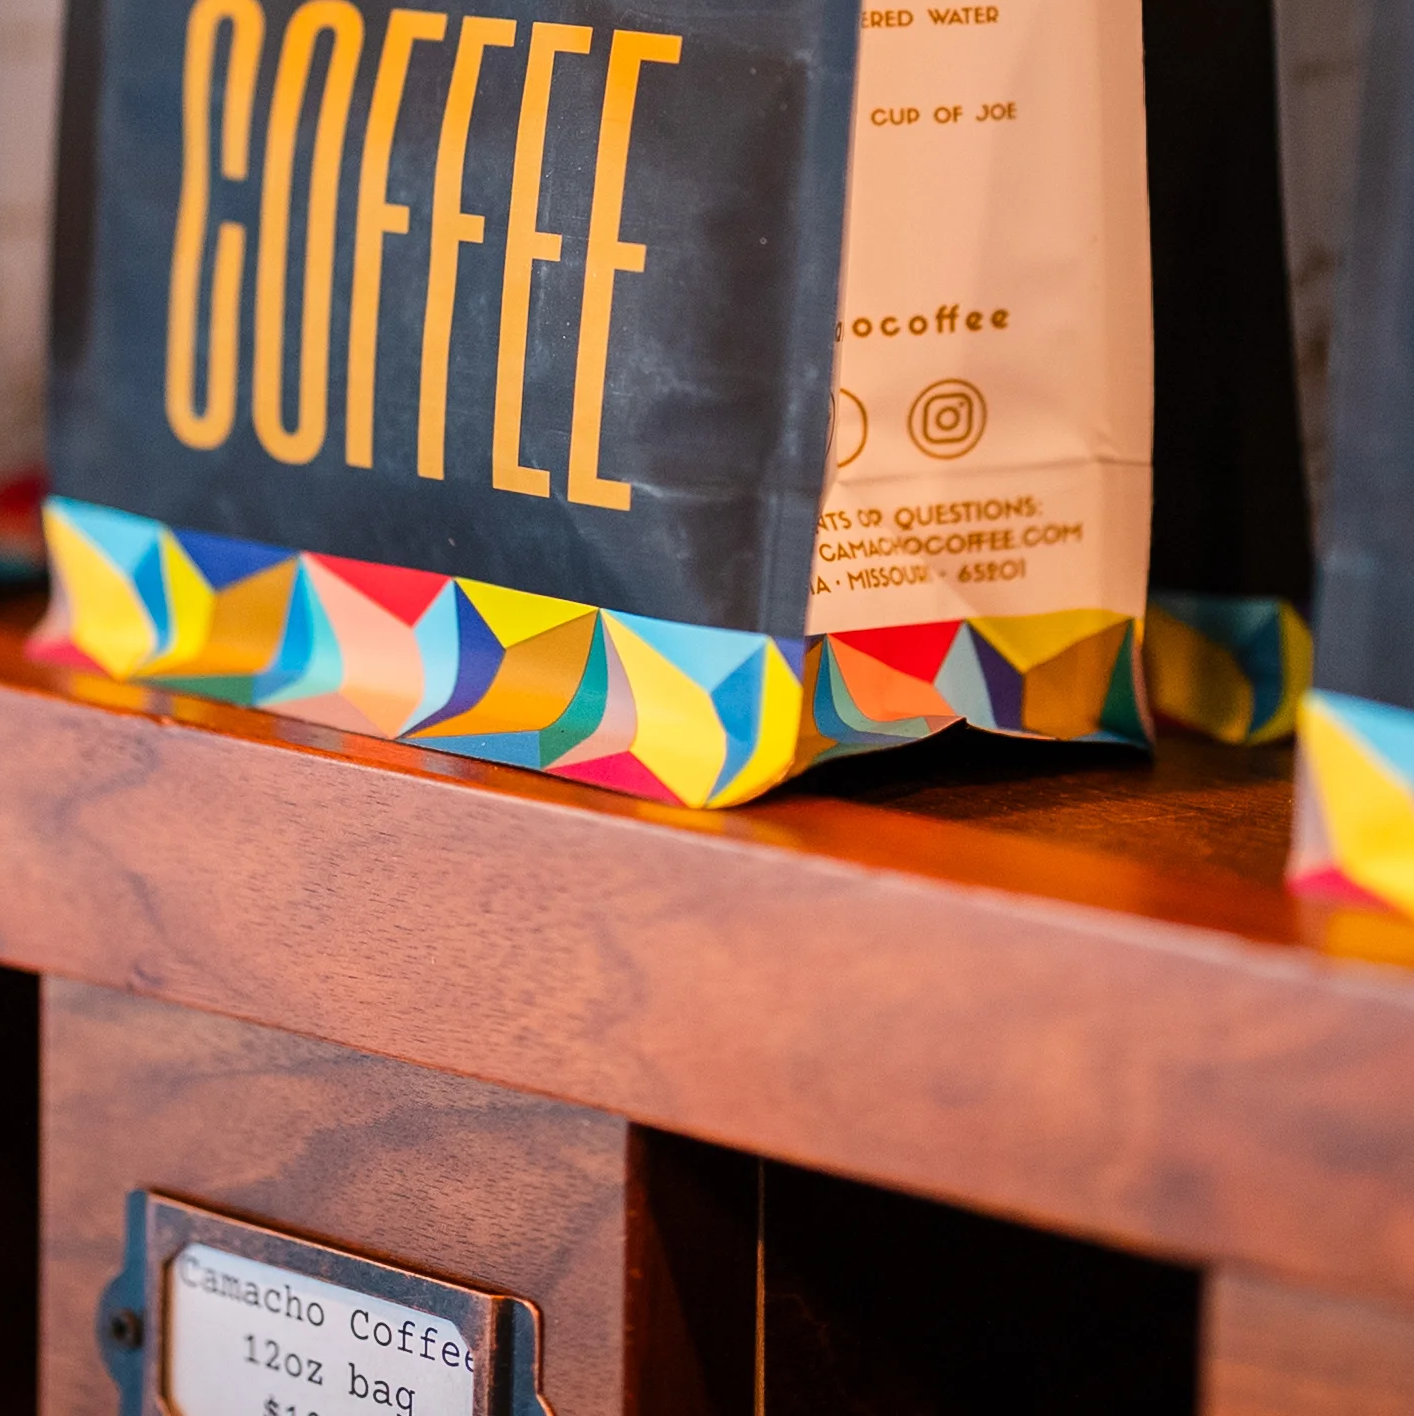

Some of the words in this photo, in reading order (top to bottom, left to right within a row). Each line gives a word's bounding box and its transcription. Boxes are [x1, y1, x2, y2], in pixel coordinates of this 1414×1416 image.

[927, 5, 999, 25] WATER
[870, 107, 920, 126] CUP
[933, 105, 963, 124] OF
[976, 101, 1017, 122] JOE
[836, 304, 1009, 342] ocoffee
[894, 494, 1043, 531] QUESTIONS:
[180, 1255, 325, 1327] Camacho
[244, 1334, 324, 1386] 12oz
[348, 1363, 416, 1416] bag
